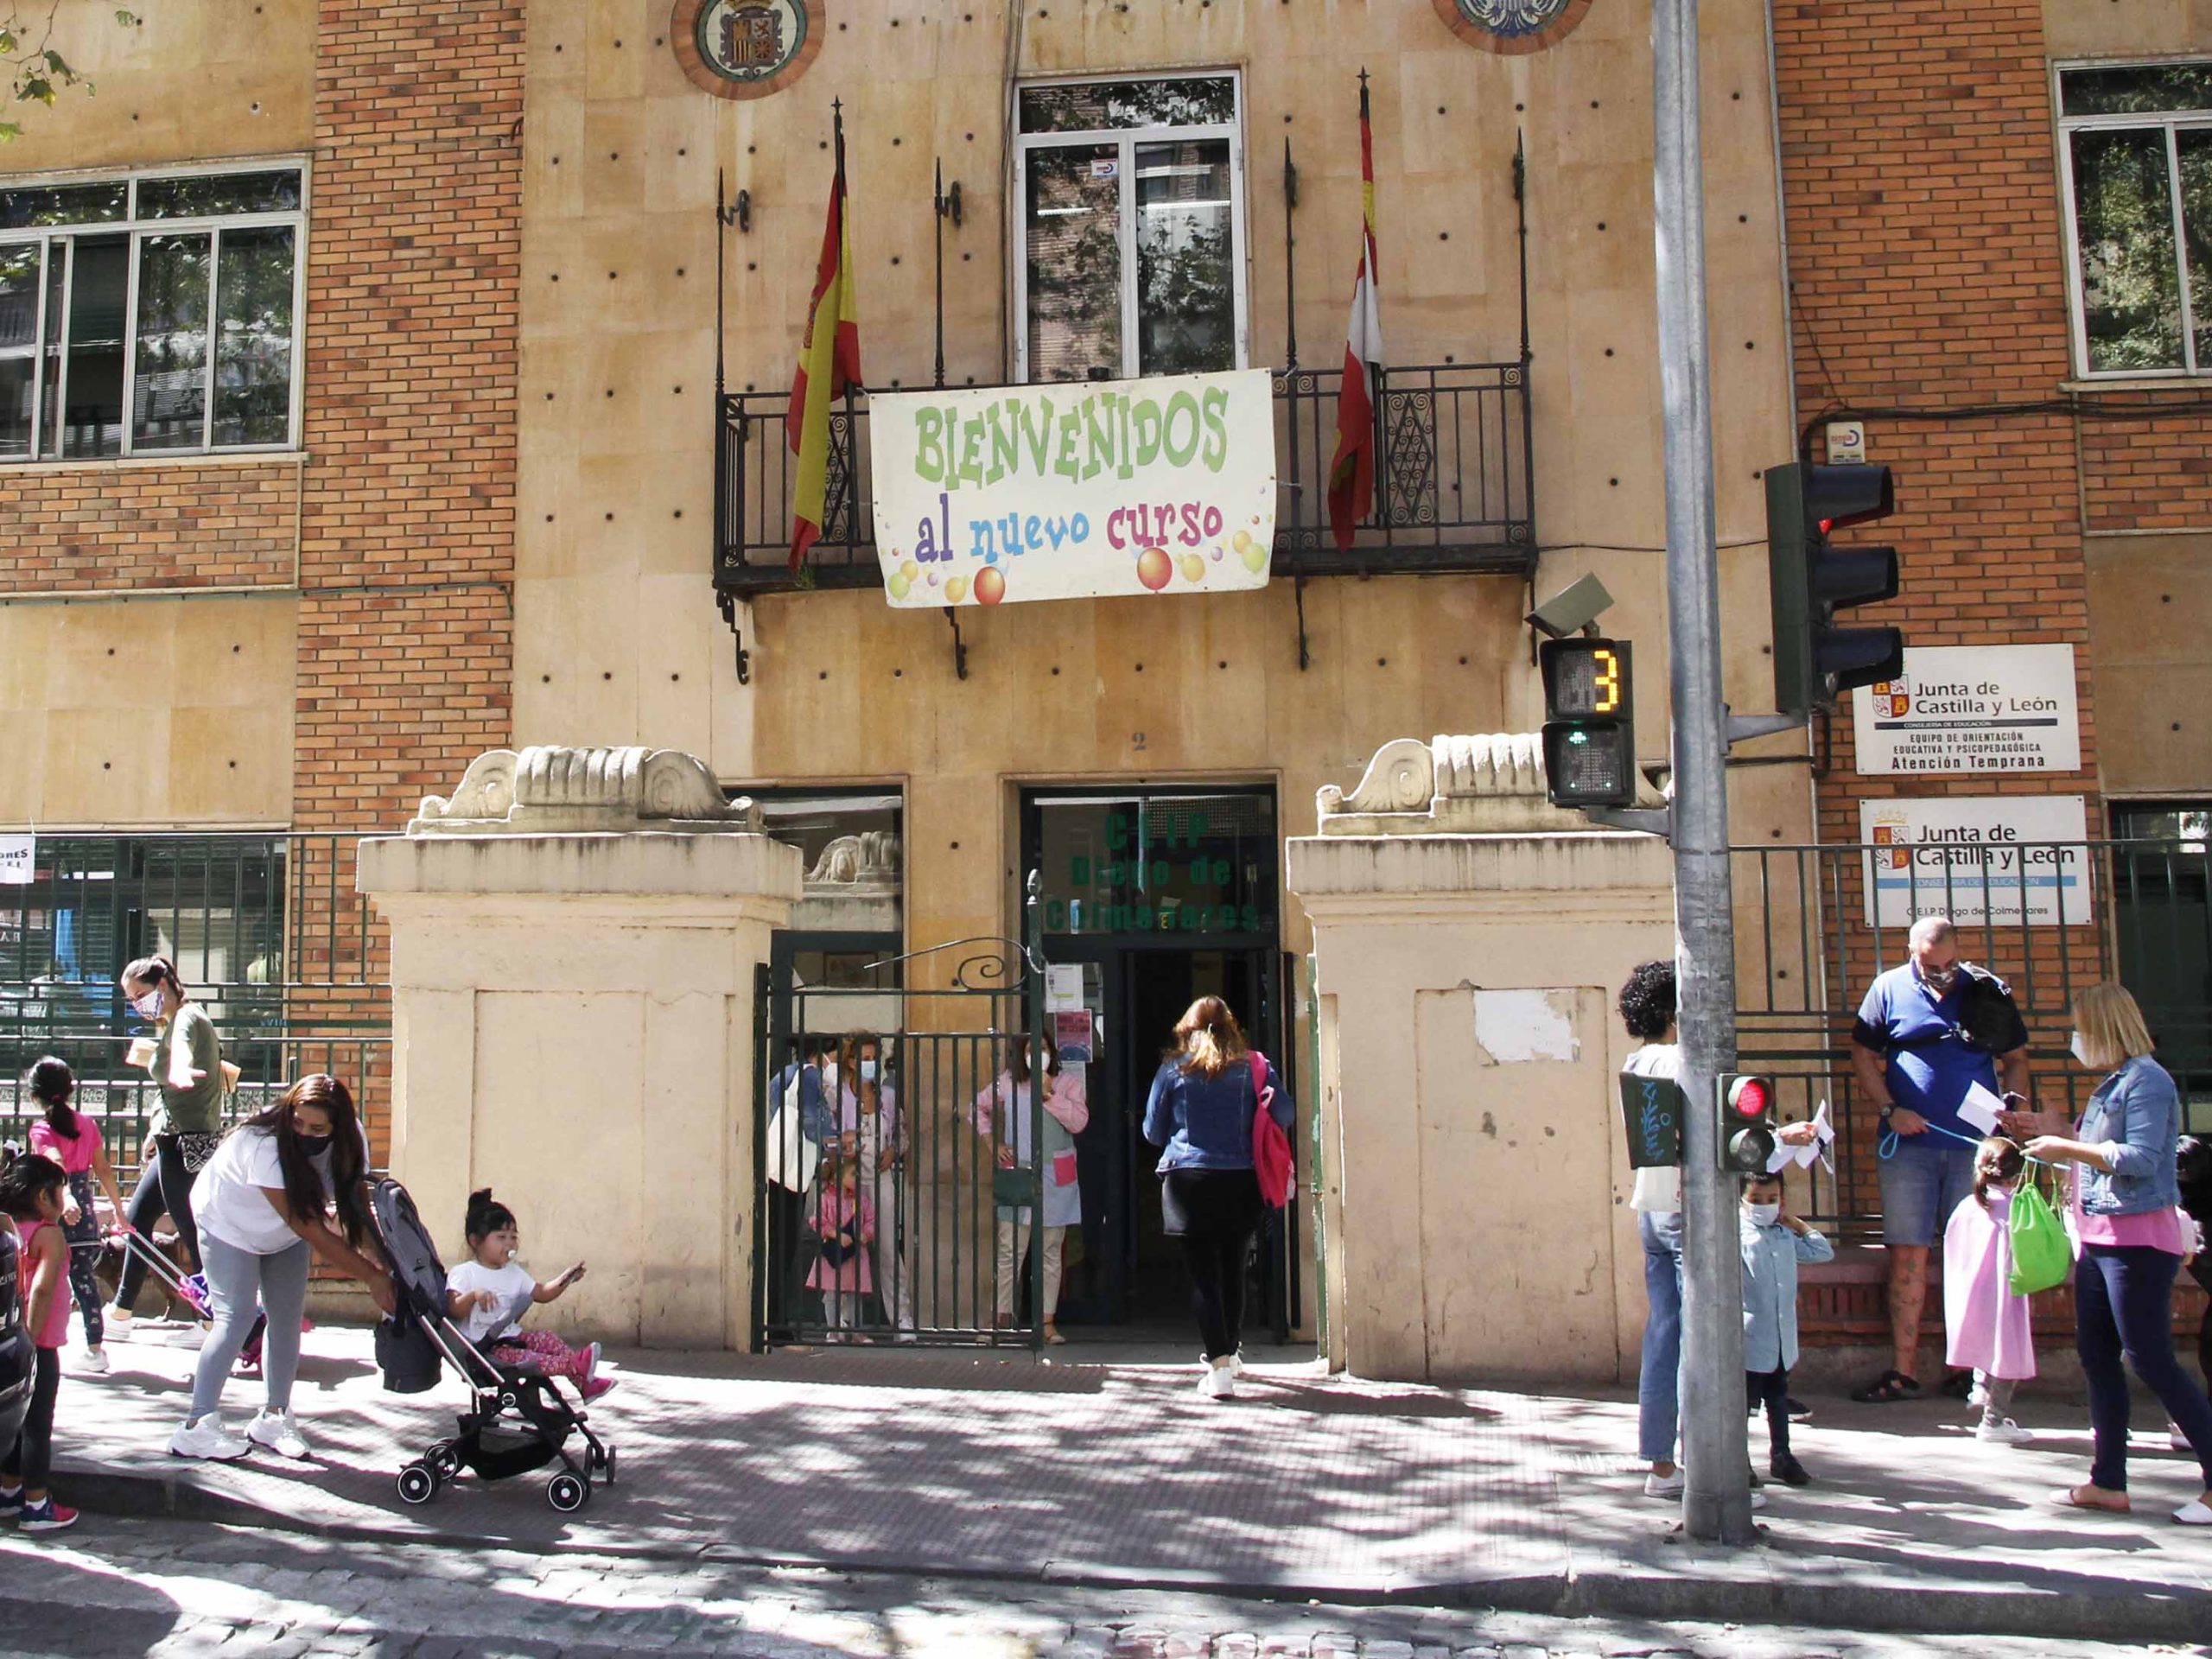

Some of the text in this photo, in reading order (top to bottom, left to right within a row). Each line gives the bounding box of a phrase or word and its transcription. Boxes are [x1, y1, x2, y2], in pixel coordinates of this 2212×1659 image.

[915, 385, 1229, 490] BIENVENIDOS
[916, 493, 1224, 563] al nuevo curso
[1594, 650, 1618, 712] 3
[1915, 681, 1999, 696] Junta de
[1916, 696, 2057, 716] Castilla y León
[1132, 733, 1147, 751] 2
[1910, 732, 2023, 743] EQUIPO DE ORIENTACIÓN
[1894, 743, 2041, 754] EDUCATIVA Y PSICOPEDAGÓGICA
[1892, 755, 2044, 769] Atención Temprana
[1917, 824, 2016, 842] Junta de
[2000, 851, 2013, 870] y
[1987, 906, 2048, 915] Colmeares
